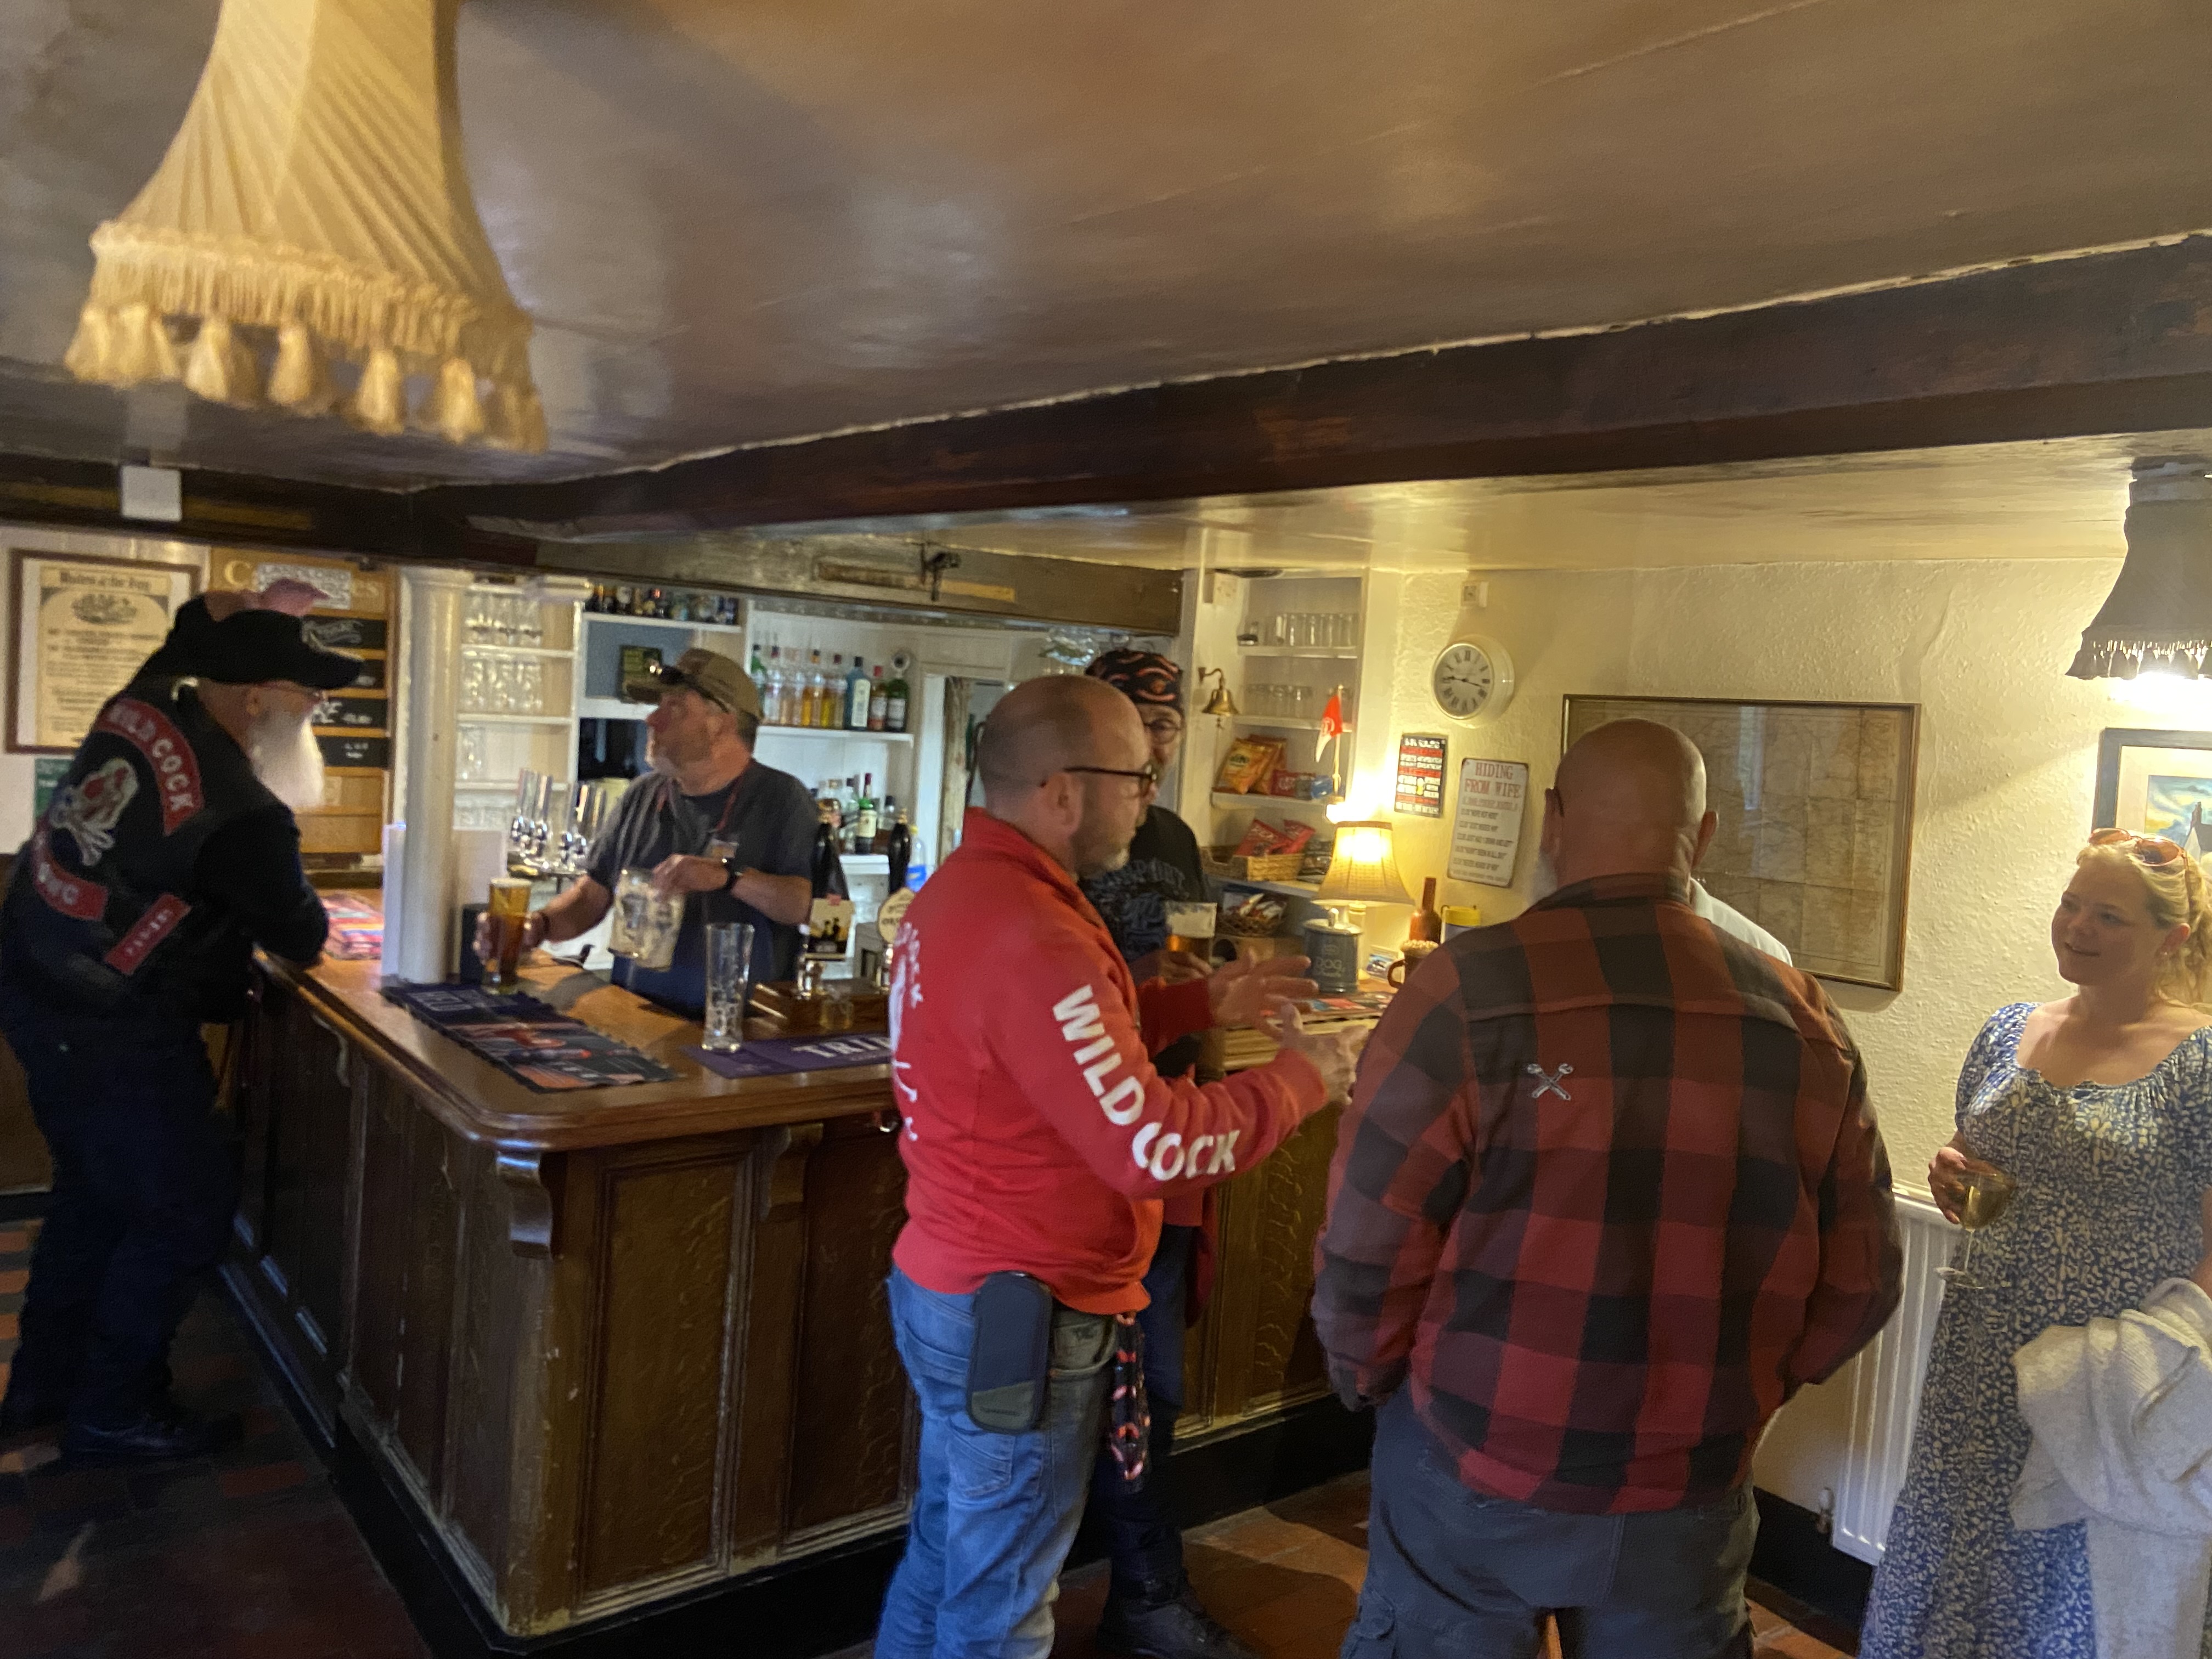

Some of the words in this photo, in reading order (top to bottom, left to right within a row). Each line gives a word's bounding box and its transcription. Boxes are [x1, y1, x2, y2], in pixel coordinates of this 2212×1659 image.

[152, 738, 194, 811] COCK
[1465, 778, 1490, 794] FROM
[1496, 782, 1522, 798] WIFE
[1475, 762, 1514, 780] HIDING
[1052, 984, 1145, 1126] WILD
[1132, 1122, 1240, 1181] COCK
